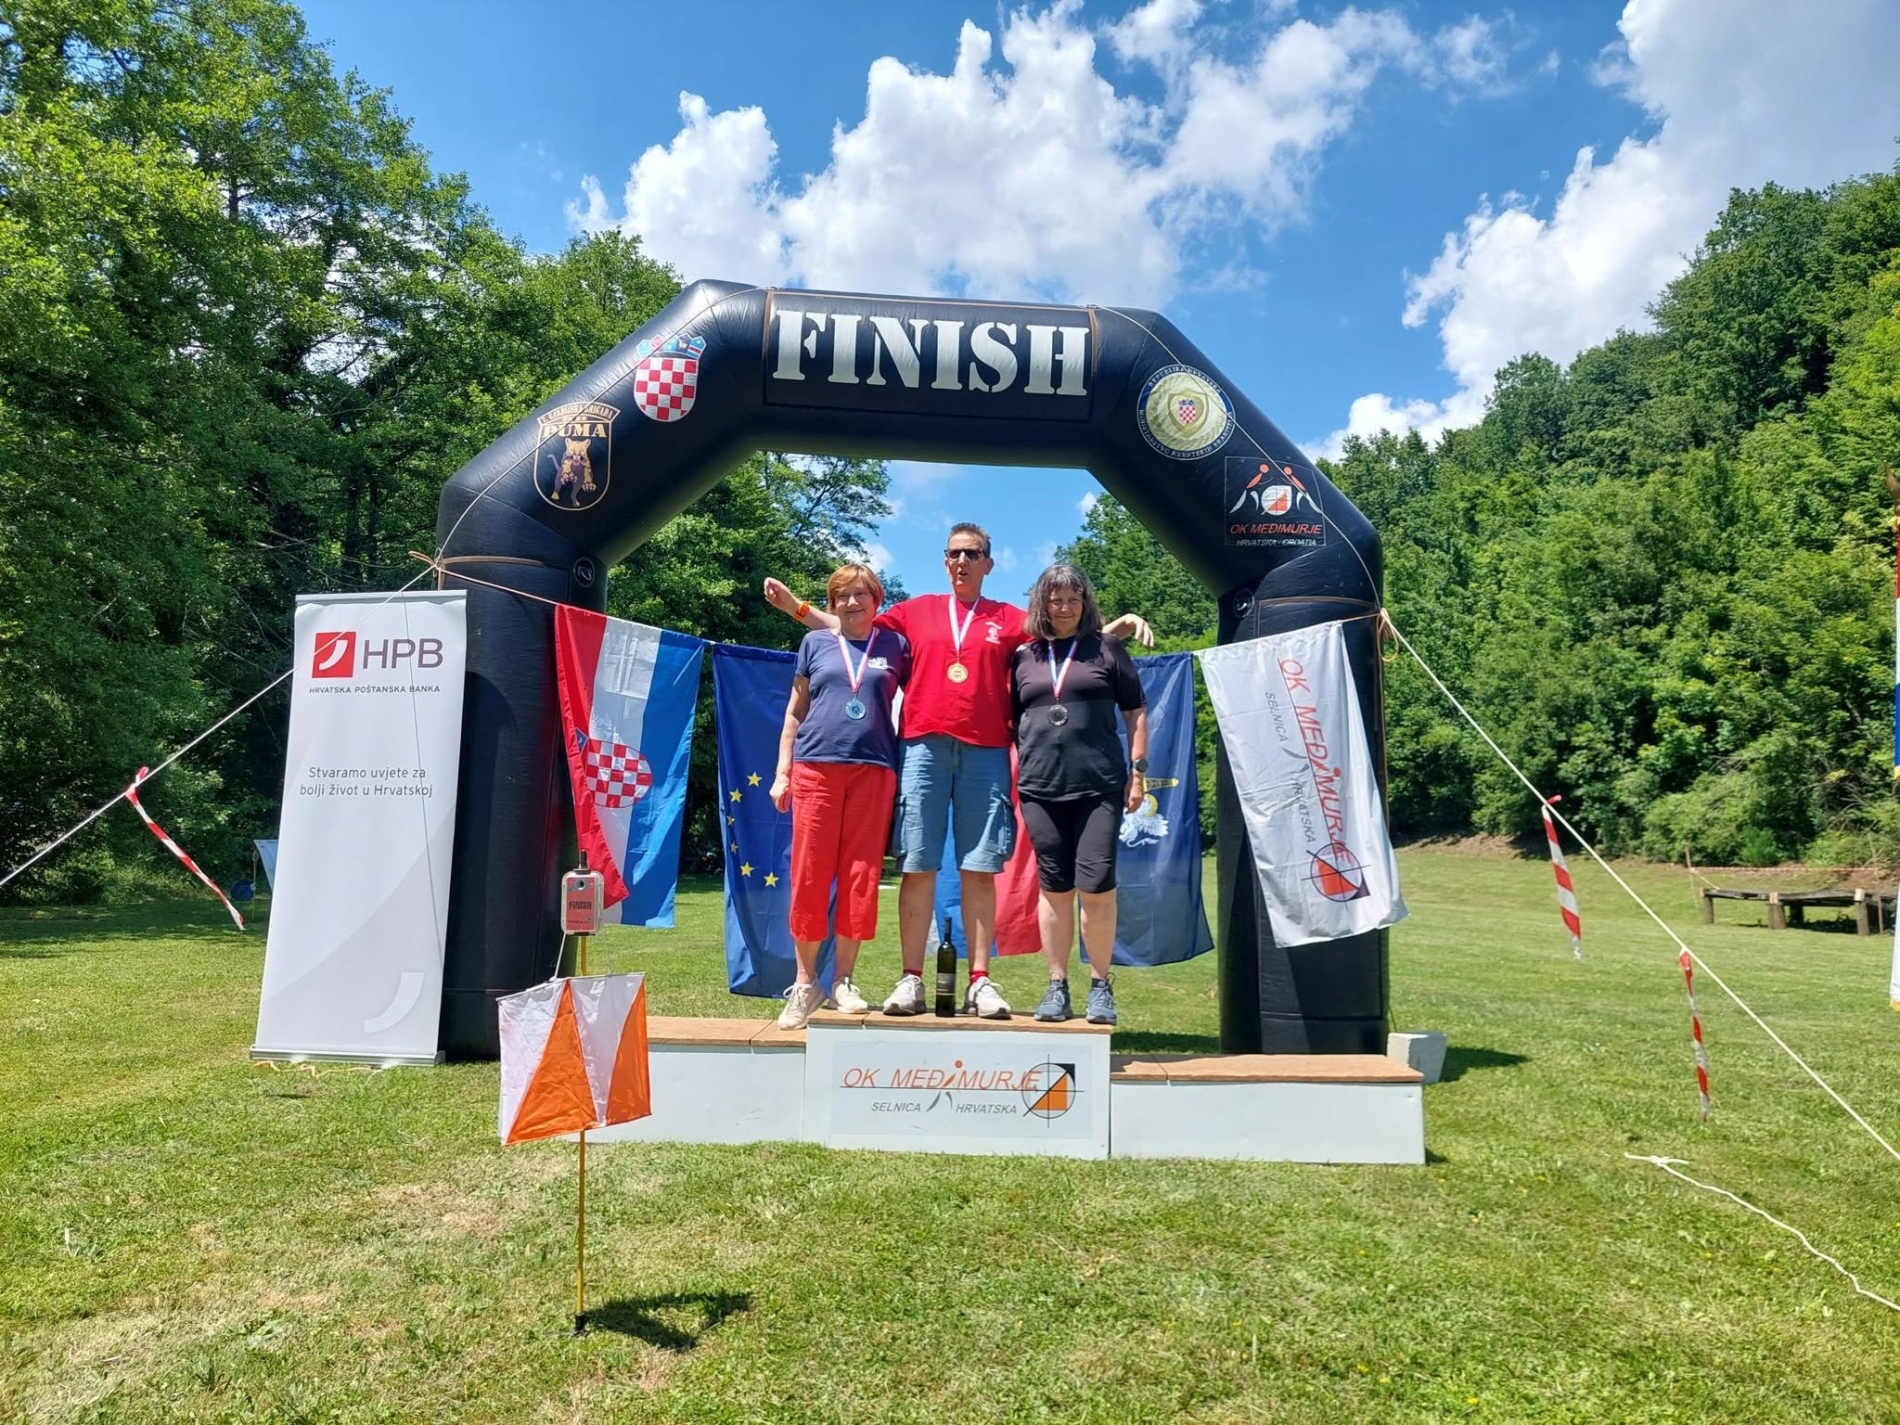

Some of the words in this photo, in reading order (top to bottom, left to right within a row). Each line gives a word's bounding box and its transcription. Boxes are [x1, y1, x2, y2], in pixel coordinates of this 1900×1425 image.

[772, 310, 1090, 396] FINISH
[542, 423, 607, 438] PUMA
[1139, 409, 1169, 455] MINISTARSTVO
[1171, 446, 1213, 458] HRVATSKIH
[1230, 524, 1249, 534] OK
[362, 637, 444, 669] HPB
[1280, 659, 1311, 693] OK
[309, 686, 351, 694] HRVATSKA
[355, 684, 406, 693] POŠTANSKA
[409, 685, 441, 693] BANKA
[1265, 691, 1289, 742] SELNICA
[309, 766, 367, 778] Stvaramo
[370, 767, 409, 781] uvjete
[412, 768, 426, 778] za
[300, 784, 325, 798] bolji
[329, 783, 359, 796] život
[362, 787, 370, 796] u
[374, 784, 433, 798] Hrvatskoj
[569, 900, 592, 910] FINISH
[843, 1067, 881, 1088] OK
[871, 1101, 922, 1113] SELNICA
[955, 1103, 1018, 1114] HRVATSKA
